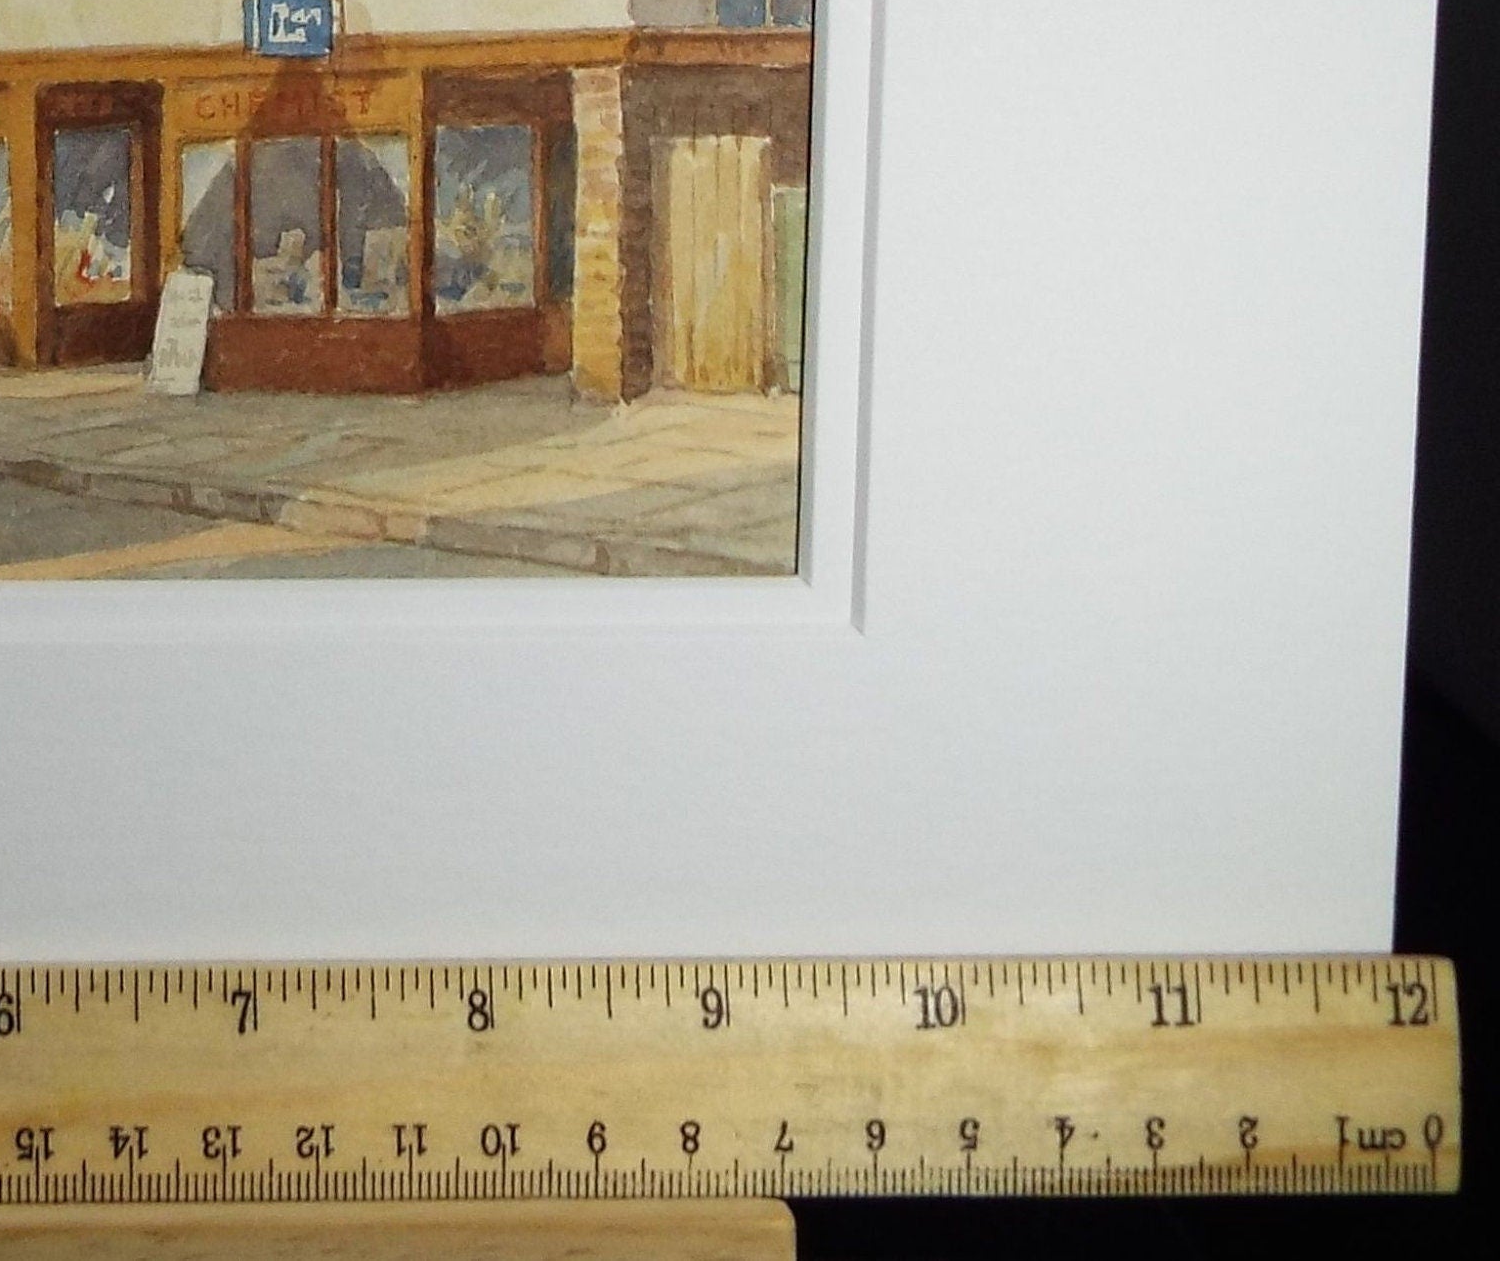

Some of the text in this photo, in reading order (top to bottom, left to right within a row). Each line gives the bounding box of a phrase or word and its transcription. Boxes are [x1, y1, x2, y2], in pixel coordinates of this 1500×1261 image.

[231, 990, 252, 1034] 7
[467, 989, 490, 1032] 8
[701, 987, 724, 1030] 9
[913, 985, 960, 1029] 10
[1148, 984, 1195, 1027] 11
[1386, 983, 1429, 1026] 12
[14, 1126, 55, 1160] 15
[109, 1125, 149, 1158] 14
[201, 1125, 243, 1159] 13
[296, 1125, 336, 1158] 12
[393, 1125, 428, 1156] 11
[480, 1123, 522, 1156] 10
[587, 1121, 607, 1154] 9
[680, 1121, 701, 1154] 8
[774, 1120, 794, 1152] 7
[865, 1119, 887, 1152] 6
[959, 1119, 980, 1152] 5
[1054, 1116, 1076, 1149] 4
[1145, 1117, 1166, 1150] 3
[1238, 1116, 1258, 1149] 2
[1336, 1116, 1350, 1148] 1
[1357, 1126, 1406, 1150] cm
[1423, 1113, 1444, 1147] 0
